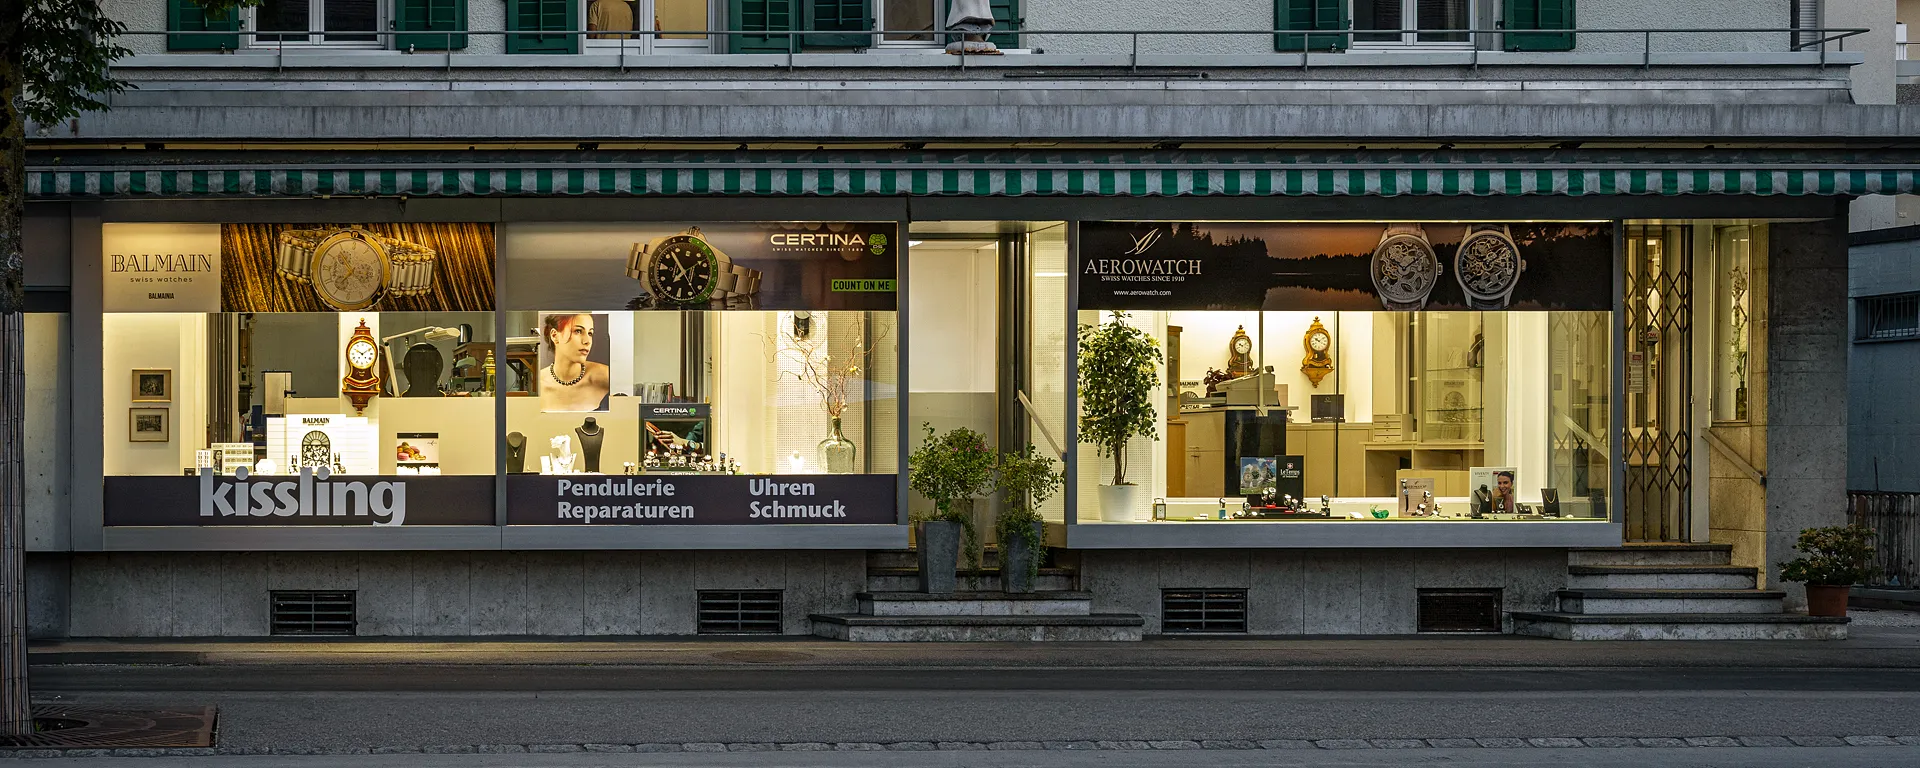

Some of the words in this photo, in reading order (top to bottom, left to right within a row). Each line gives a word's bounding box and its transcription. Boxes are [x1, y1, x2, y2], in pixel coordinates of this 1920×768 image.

[770, 233, 866, 246] CERTINA
[110, 254, 212, 272] BALMAIN
[1084, 259, 1202, 275] AEROWATCH
[833, 280, 862, 290] COUNT
[863, 280, 876, 290] ON
[878, 280, 890, 290] ME
[148, 292, 175, 300] BALMAINIA
[200, 465, 406, 527] kissling
[557, 478, 675, 496] Pendulerie
[749, 478, 815, 496] Uhren
[557, 501, 694, 523] Reparaturen
[749, 500, 847, 518] Schmuck
